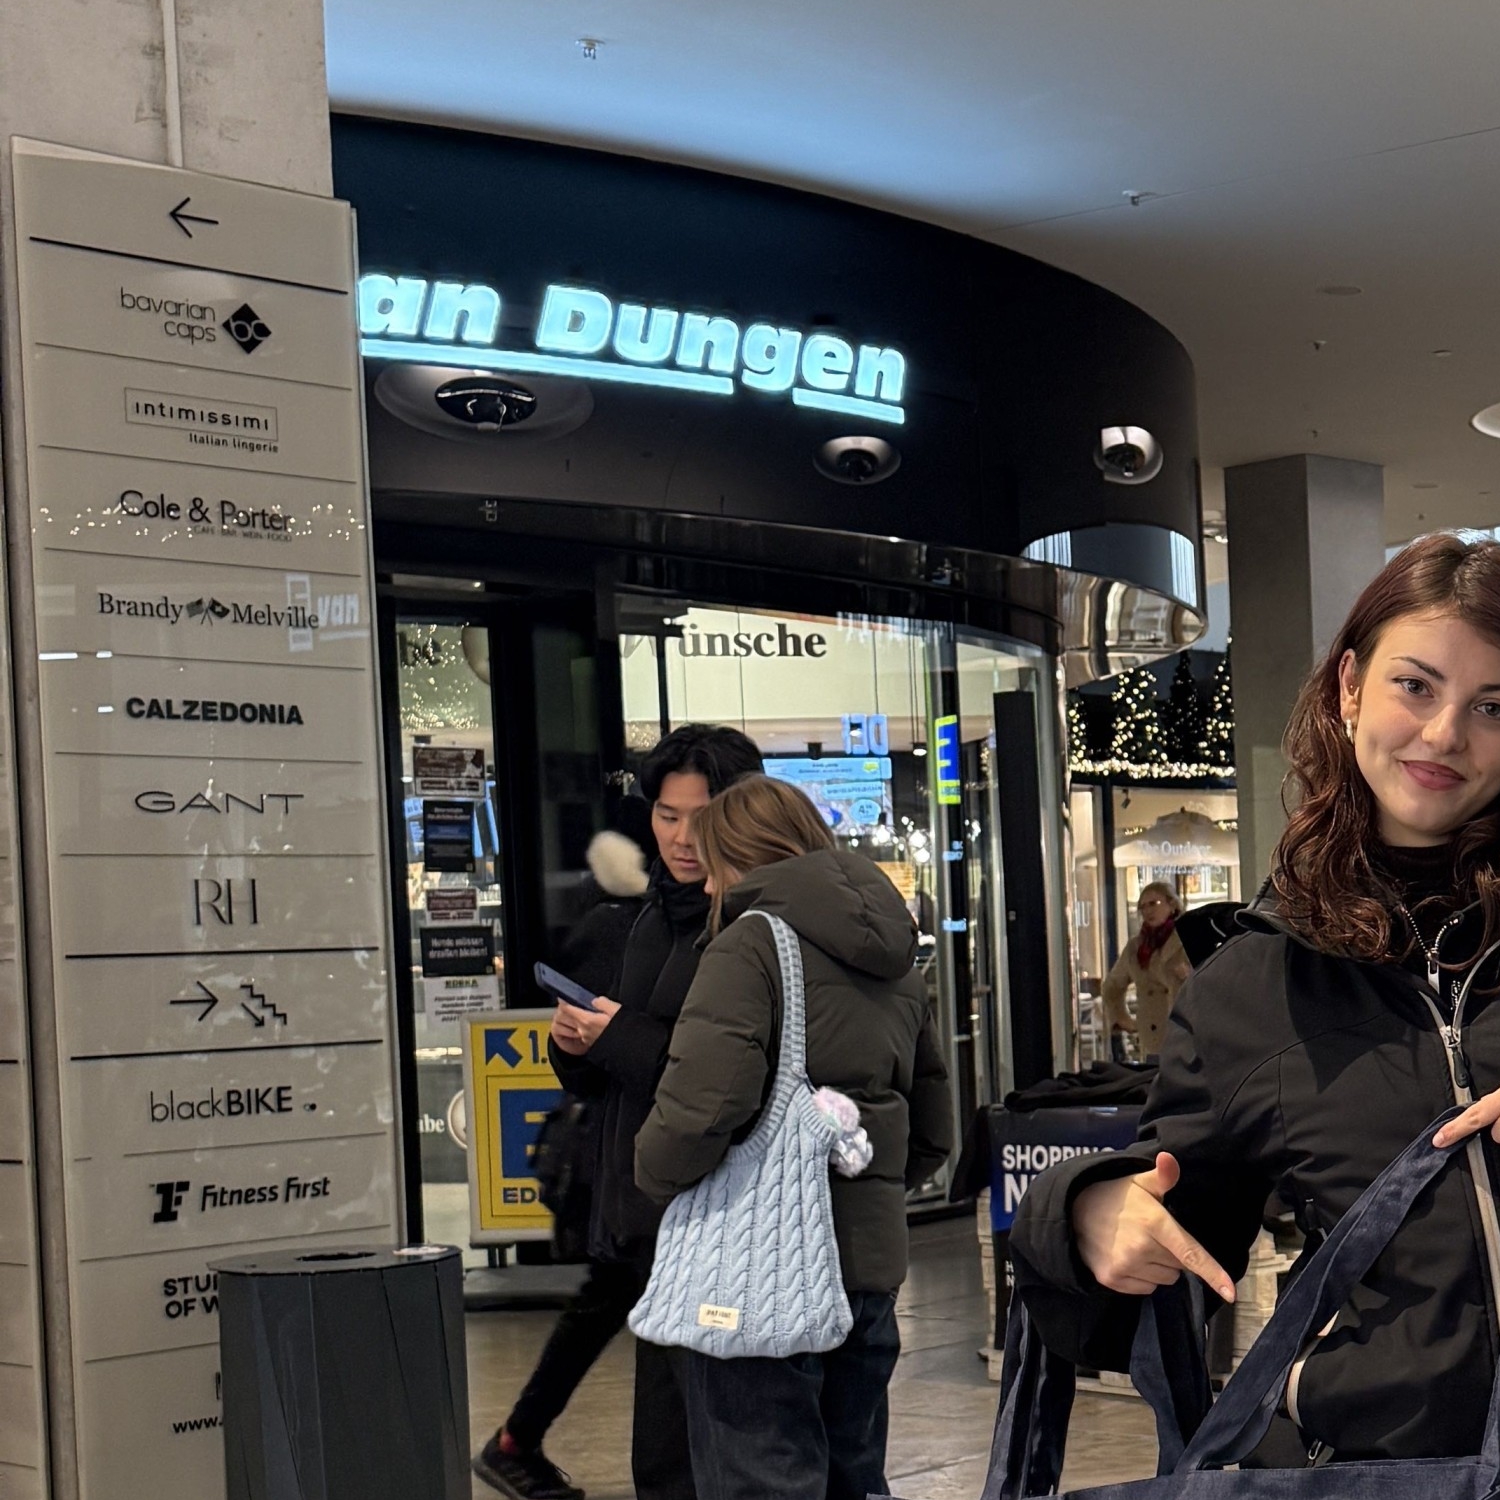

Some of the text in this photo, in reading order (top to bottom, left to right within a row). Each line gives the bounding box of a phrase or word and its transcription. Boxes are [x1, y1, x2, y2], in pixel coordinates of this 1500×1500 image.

[120, 286, 216, 322] bavarian
[164, 320, 216, 345] caps
[536, 283, 904, 401] Dungen
[135, 402, 269, 431] intimissimi
[189, 433, 278, 452] Italian lingerie
[120, 489, 292, 531] Cole & Porter
[98, 592, 319, 630] Brandy Melville
[125, 697, 304, 726] CALZEDONIA
[135, 790, 304, 815] GANT
[150, 1085, 293, 1122] blackBIKE
[165, 1298, 197, 1319] OF
